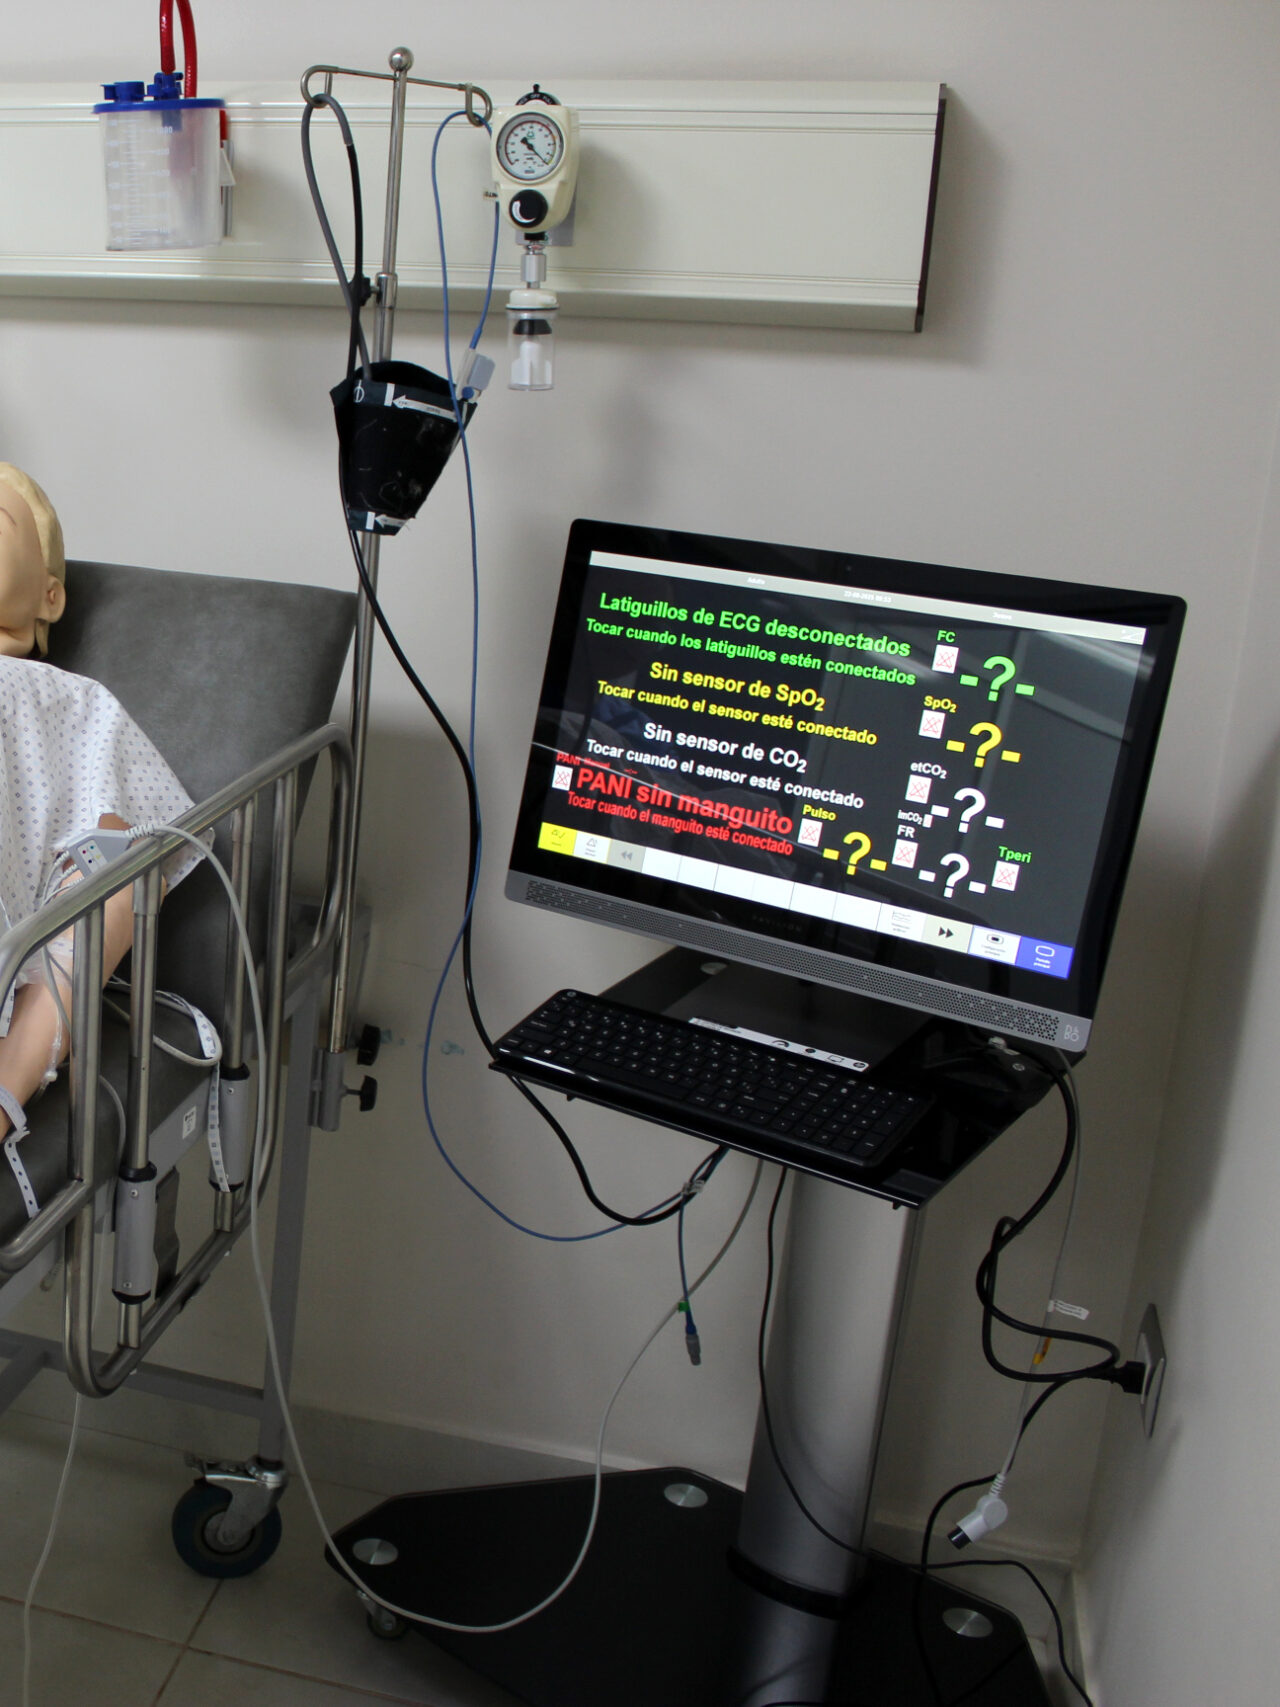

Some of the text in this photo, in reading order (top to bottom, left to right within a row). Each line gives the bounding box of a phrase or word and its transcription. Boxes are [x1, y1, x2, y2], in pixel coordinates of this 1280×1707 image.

[599, 592, 912, 657] Latiguillos de ECG desconectados
[937, 629, 957, 643] FC
[586, 617, 917, 686] Tocar cuando los latiguillos estén conectados
[649, 661, 679, 682] Sin
[682, 670, 746, 694] sensor
[748, 680, 772, 698] de
[597, 680, 878, 746] Tocar cuando el sensor esté conectado
[555, 752, 582, 767] PANI
[643, 721, 673, 742] Sin
[675, 731, 739, 756] sensor
[741, 742, 765, 761] de
[586, 738, 865, 809] Tocar cuando el sensor esté conectado
[576, 767, 793, 835] PANI sin manguito
[802, 804, 838, 821] Pulso
[567, 790, 794, 856] Tocar cuando el manguito esté conectado
[897, 824, 916, 839] FR
[998, 845, 1033, 864] Tperi
